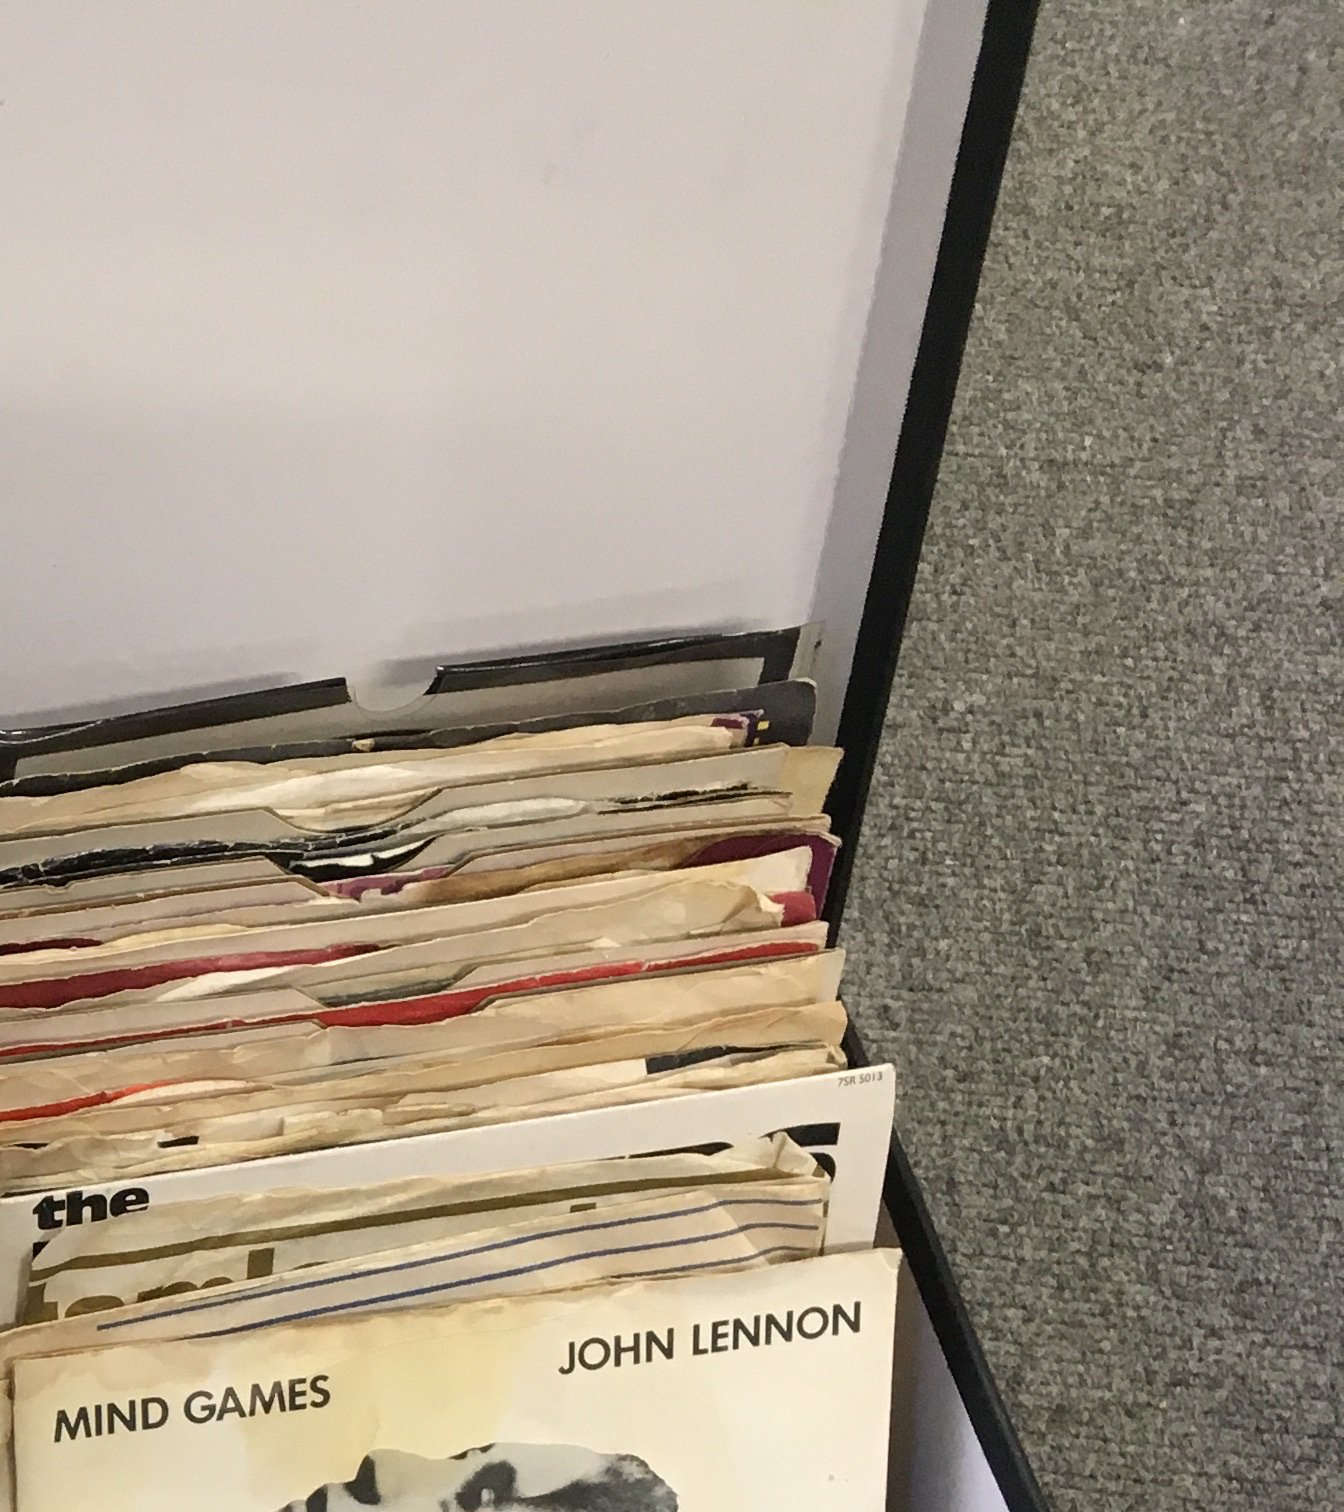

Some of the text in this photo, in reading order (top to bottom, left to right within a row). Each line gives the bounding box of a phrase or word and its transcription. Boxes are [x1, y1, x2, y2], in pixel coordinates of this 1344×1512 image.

[32, 1187, 150, 1230] the
[558, 1301, 861, 1375] JOHN LENNON
[54, 1375, 331, 1443] MIND GAMES
